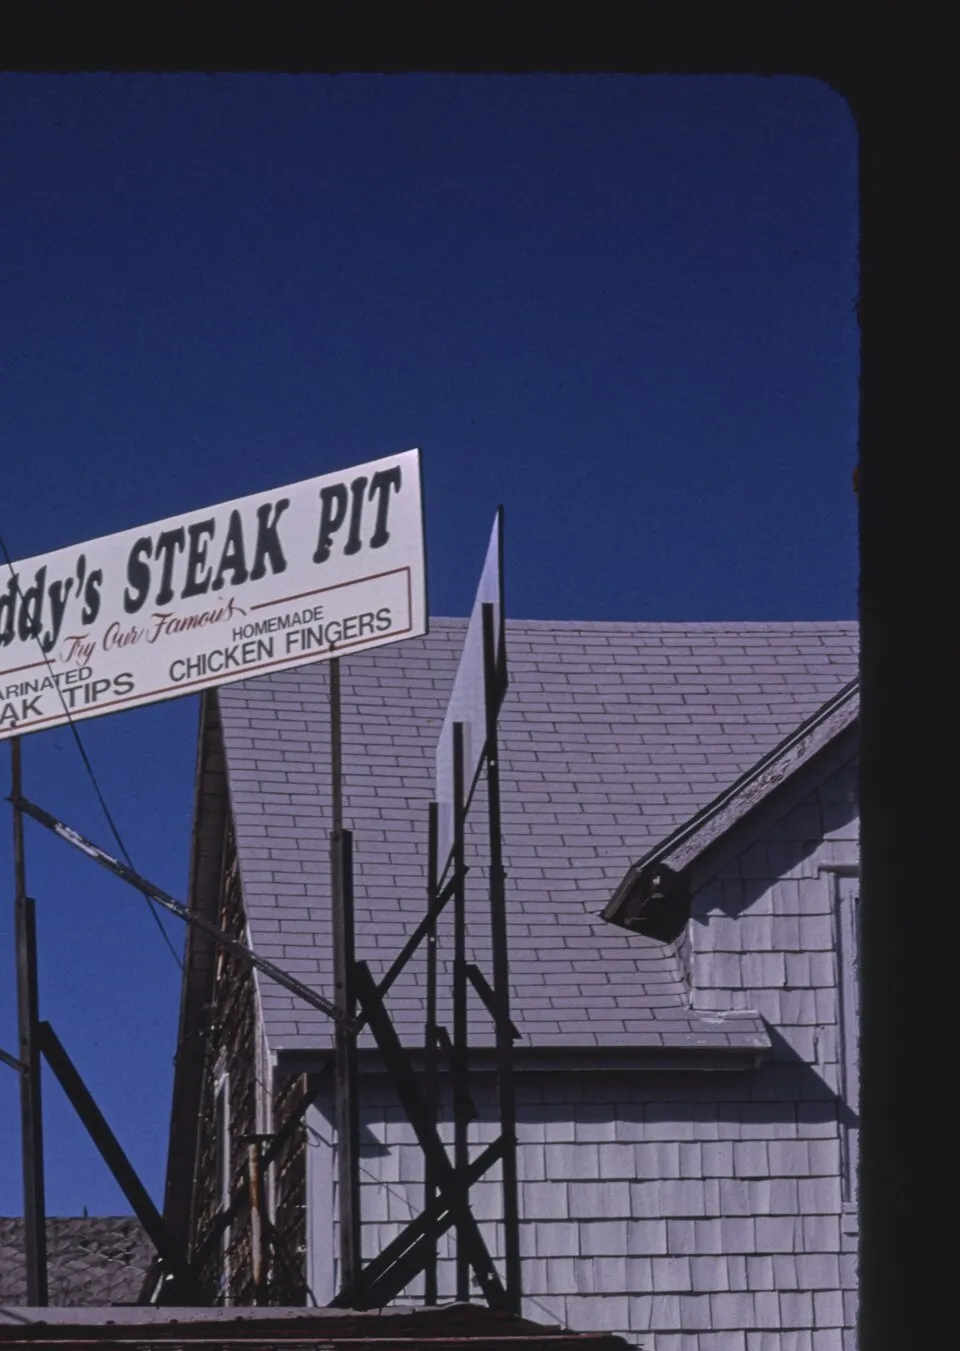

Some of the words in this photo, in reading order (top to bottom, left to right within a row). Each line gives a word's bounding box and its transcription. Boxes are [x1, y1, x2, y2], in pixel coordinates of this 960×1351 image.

[123, 498, 290, 614] STEAK
[312, 465, 402, 564] PIT
[60, 633, 96, 667] Try
[102, 621, 142, 651] Our
[145, 596, 247, 643] Famous
[169, 637, 274, 682] CHICKEN
[286, 607, 393, 654] FINGERS
[232, 606, 324, 642] HOMEMADE
[62, 672, 135, 708] TIPS
